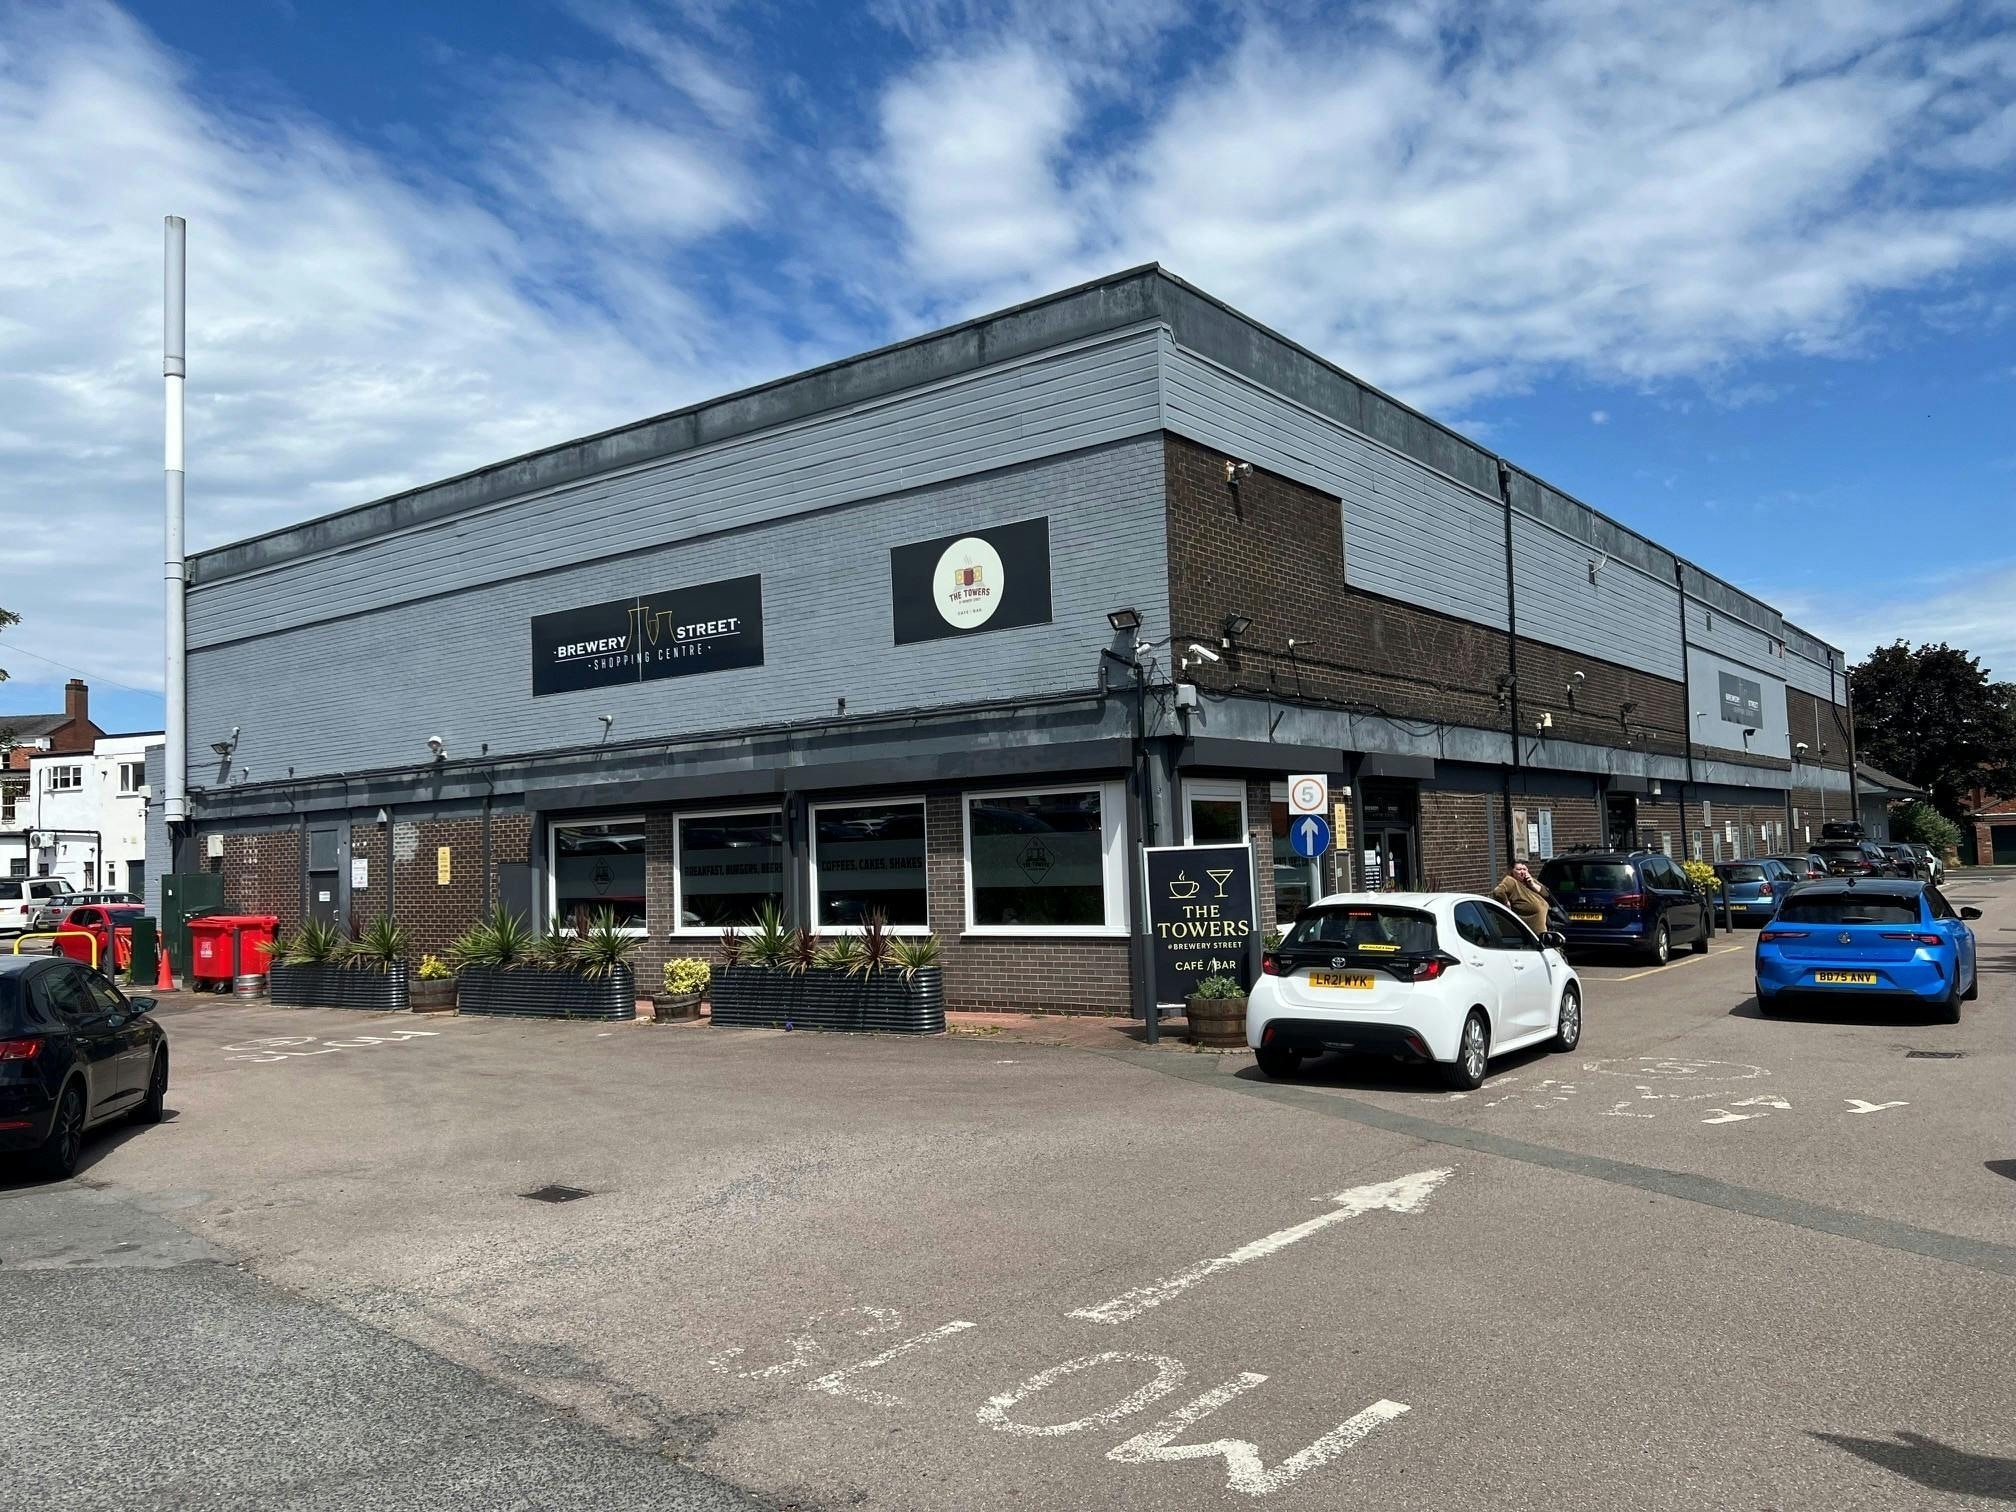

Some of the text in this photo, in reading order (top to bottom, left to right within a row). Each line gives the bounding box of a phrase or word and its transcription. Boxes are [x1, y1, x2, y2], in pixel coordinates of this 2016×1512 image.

[949, 591, 962, 602] THE
[963, 587, 991, 598] TOWERS
[557, 617, 738, 658] BREWERY STREET
[593, 643, 703, 671] SHOPPING CENTRE
[1301, 786, 1314, 803] 5
[821, 856, 924, 873] COFFEES, CAKES, SHAKES
[1182, 904, 1220, 918] THE
[1157, 920, 1249, 938] TOWERS
[1213, 941, 1242, 949] STREET
[1175, 959, 1204, 971] CAFÉ
[1315, 973, 1368, 987] LR21 WYK
[1819, 971, 1872, 983] BD75 ANV
[706, 1306, 1413, 1497] SLOW
